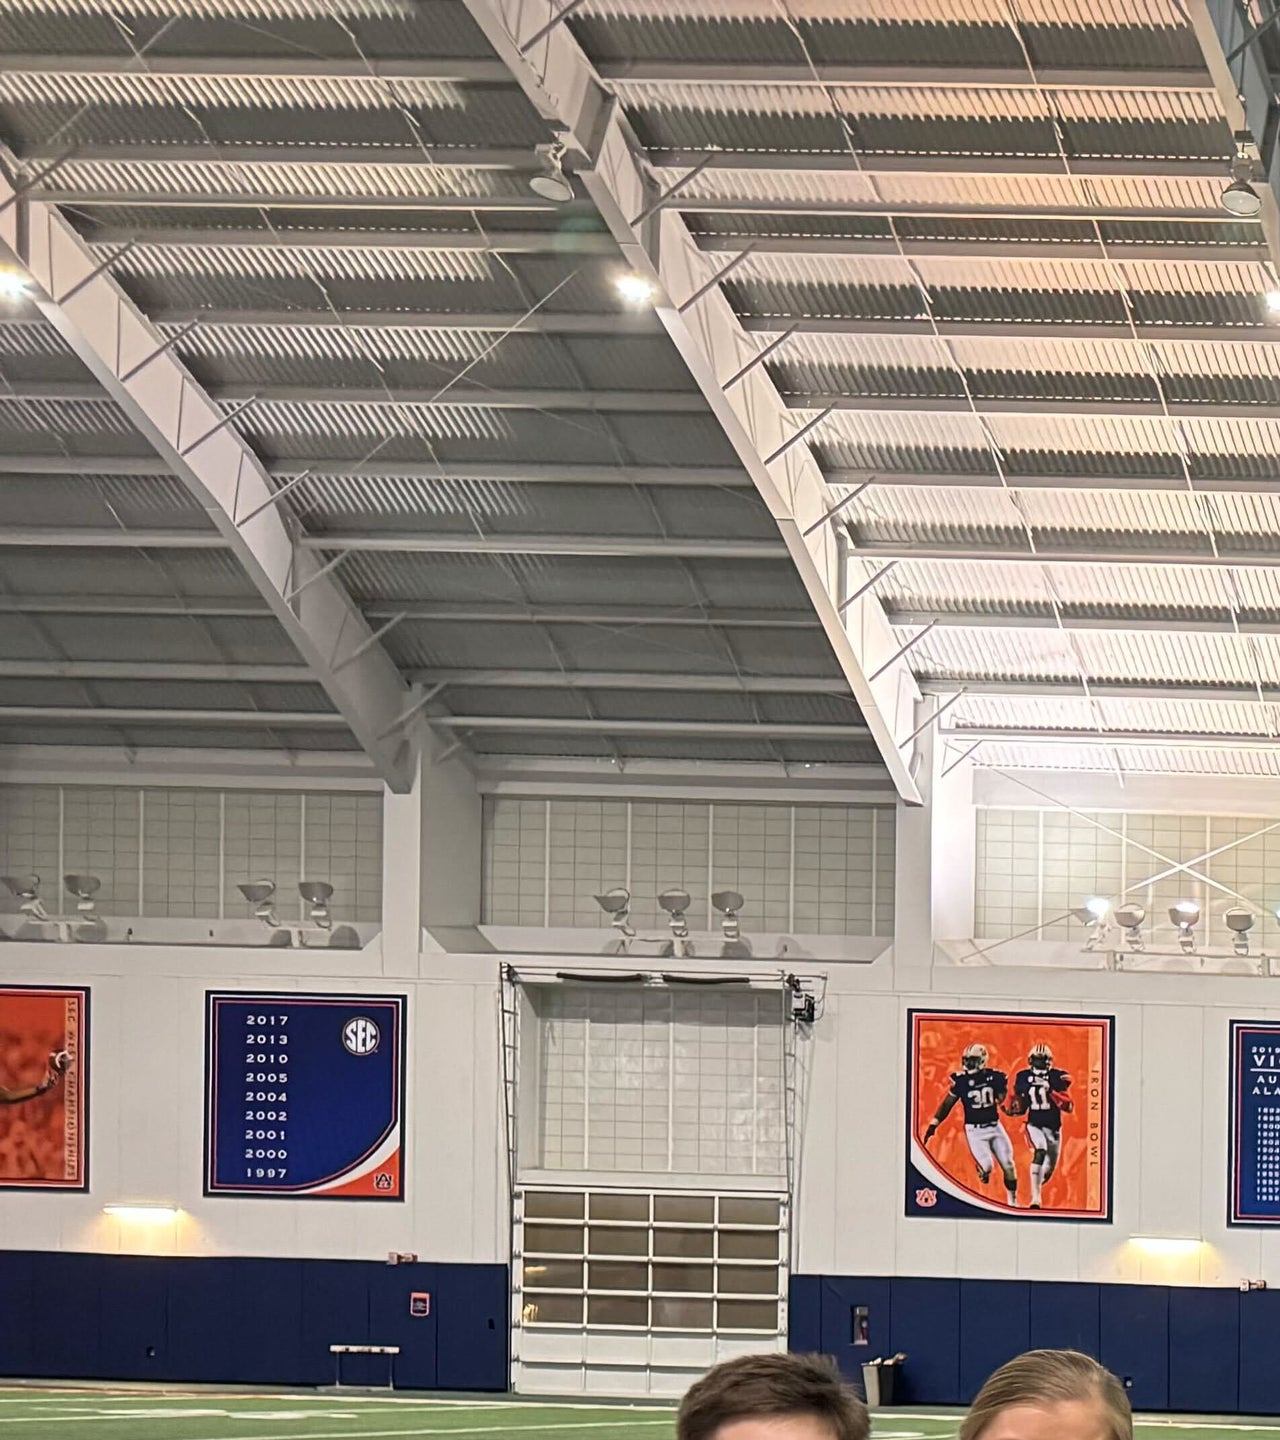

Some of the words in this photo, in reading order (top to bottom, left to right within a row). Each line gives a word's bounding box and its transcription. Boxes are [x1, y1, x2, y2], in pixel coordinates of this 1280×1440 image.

[246, 1016, 288, 1025] 2017
[246, 1035, 288, 1044] 2013
[345, 1020, 377, 1053] SEC
[1252, 1046, 1280, 1054] 2019
[246, 1054, 288, 1064] 2010
[246, 1073, 288, 1083] 2005
[1091, 1070, 1099, 1111] IRON
[245, 1092, 287, 1102] 2004
[968, 1086, 994, 1108] 30
[1028, 1086, 1050, 1110] 11
[245, 1111, 287, 1121] 2002
[245, 1130, 285, 1140] 2001
[1090, 1122, 1099, 1167] BOWL
[245, 1149, 287, 1159] 2000
[247, 1168, 286, 1178] 1997
